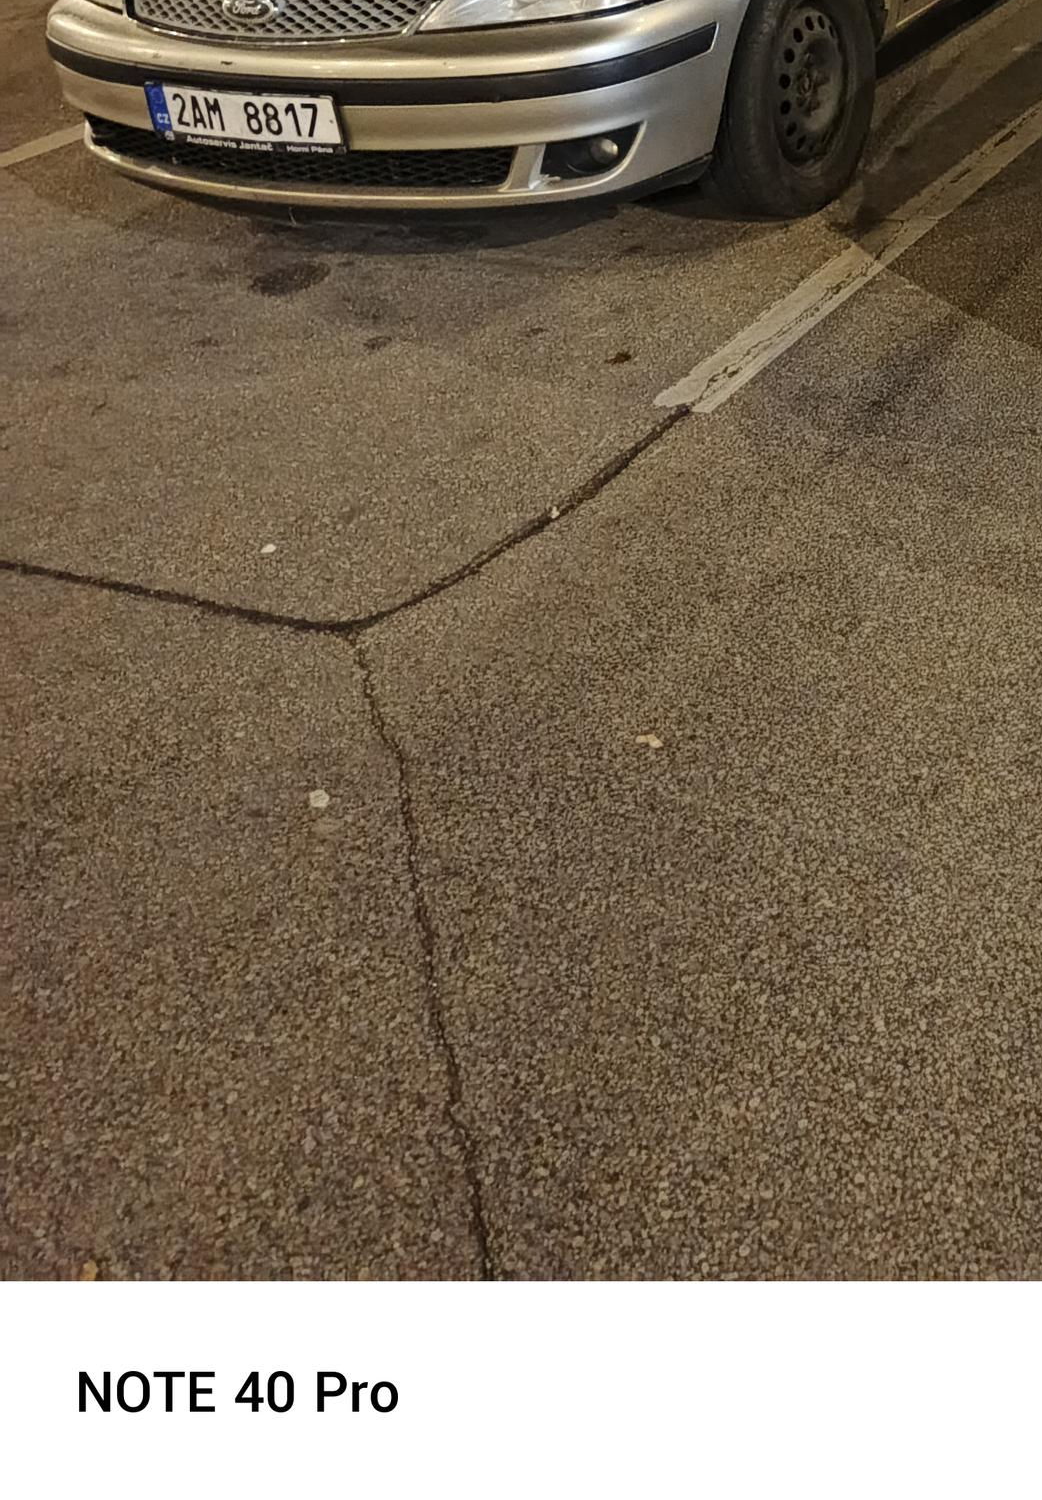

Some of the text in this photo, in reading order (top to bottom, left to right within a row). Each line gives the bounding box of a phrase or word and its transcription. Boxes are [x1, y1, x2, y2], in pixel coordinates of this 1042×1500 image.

[232, 0, 261, 15] Ford
[156, 113, 171, 125] CZ
[172, 92, 319, 138] 2AM 8817
[186, 134, 237, 150] Autoservis
